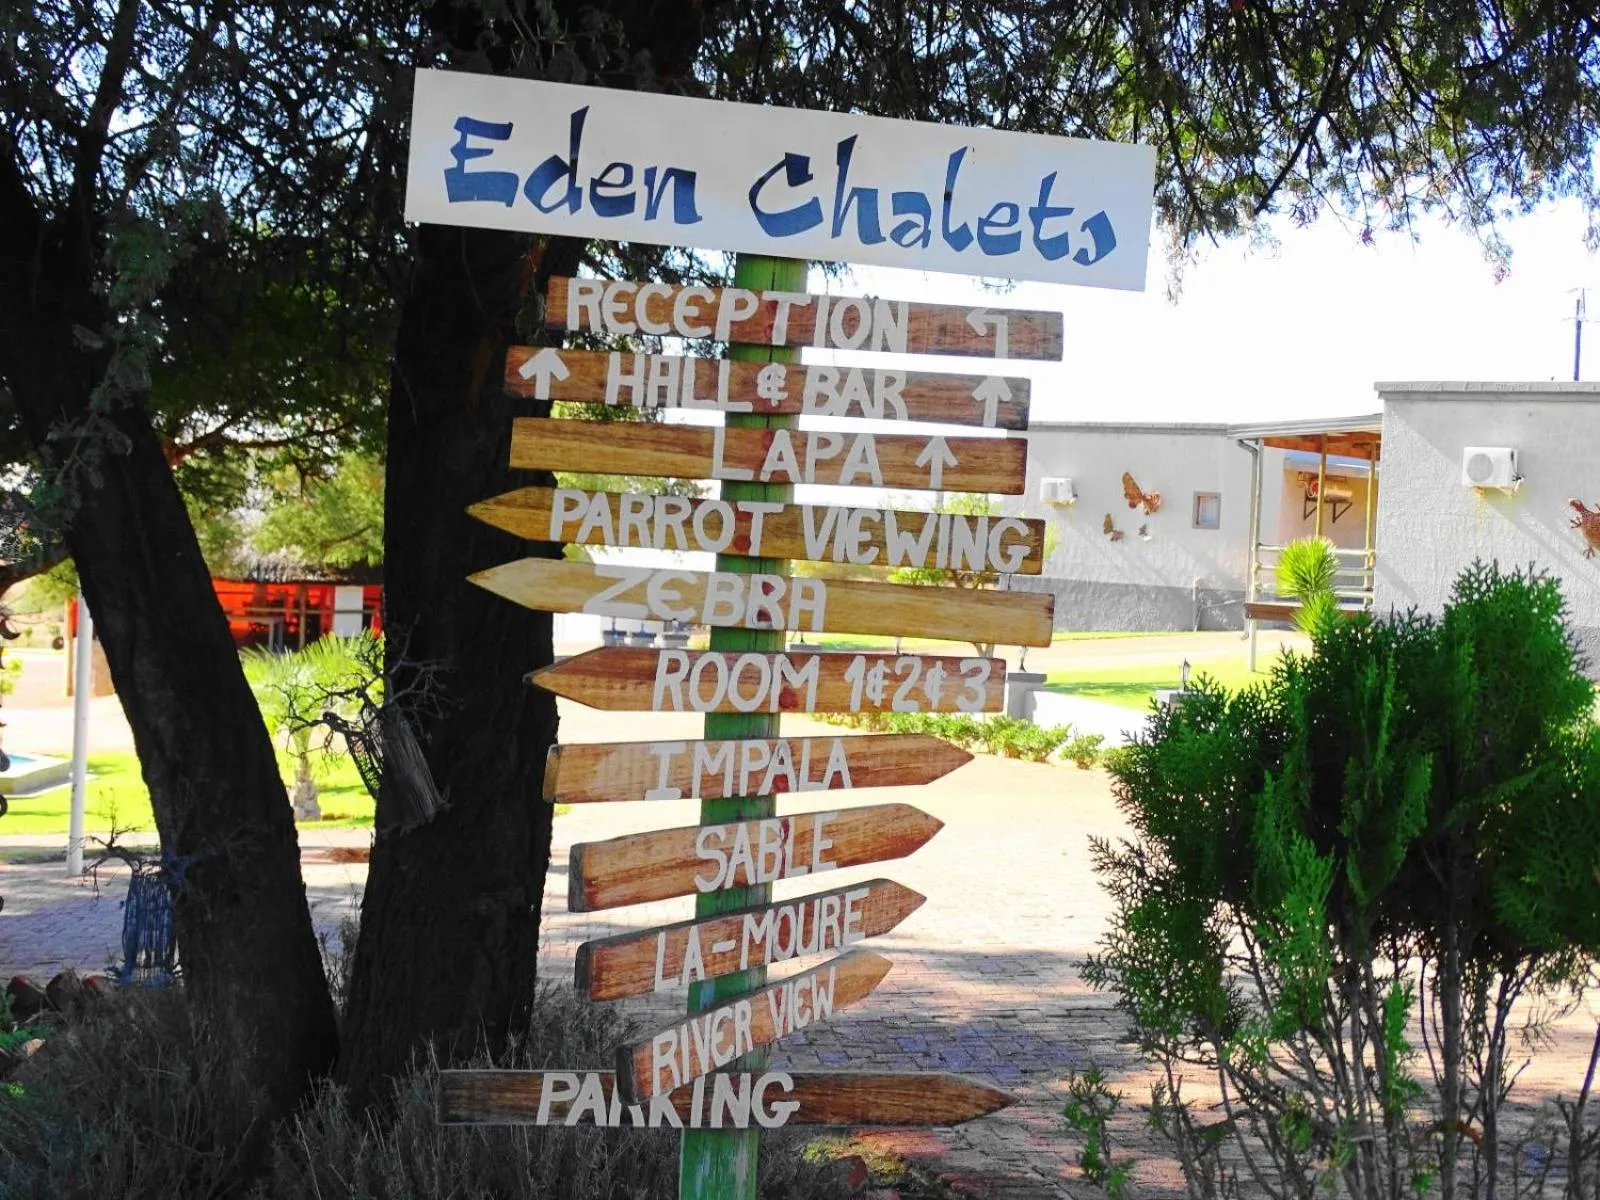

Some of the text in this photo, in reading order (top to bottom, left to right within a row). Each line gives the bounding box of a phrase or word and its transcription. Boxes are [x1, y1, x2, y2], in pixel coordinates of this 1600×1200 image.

[443, 104, 1117, 267] Eden Chalets
[566, 277, 908, 354] RECEPTION
[604, 350, 908, 420] HALL & BAR
[711, 426, 883, 485] LAPA
[548, 488, 1031, 573] PARROT VIEWING
[582, 563, 826, 632] ZEBRA
[652, 650, 820, 712] ROOM
[644, 738, 853, 801] IMPALA
[694, 811, 838, 893] SABLE
[654, 887, 870, 992] LA-MOURE
[651, 965, 836, 1097] RIVER VIEW
